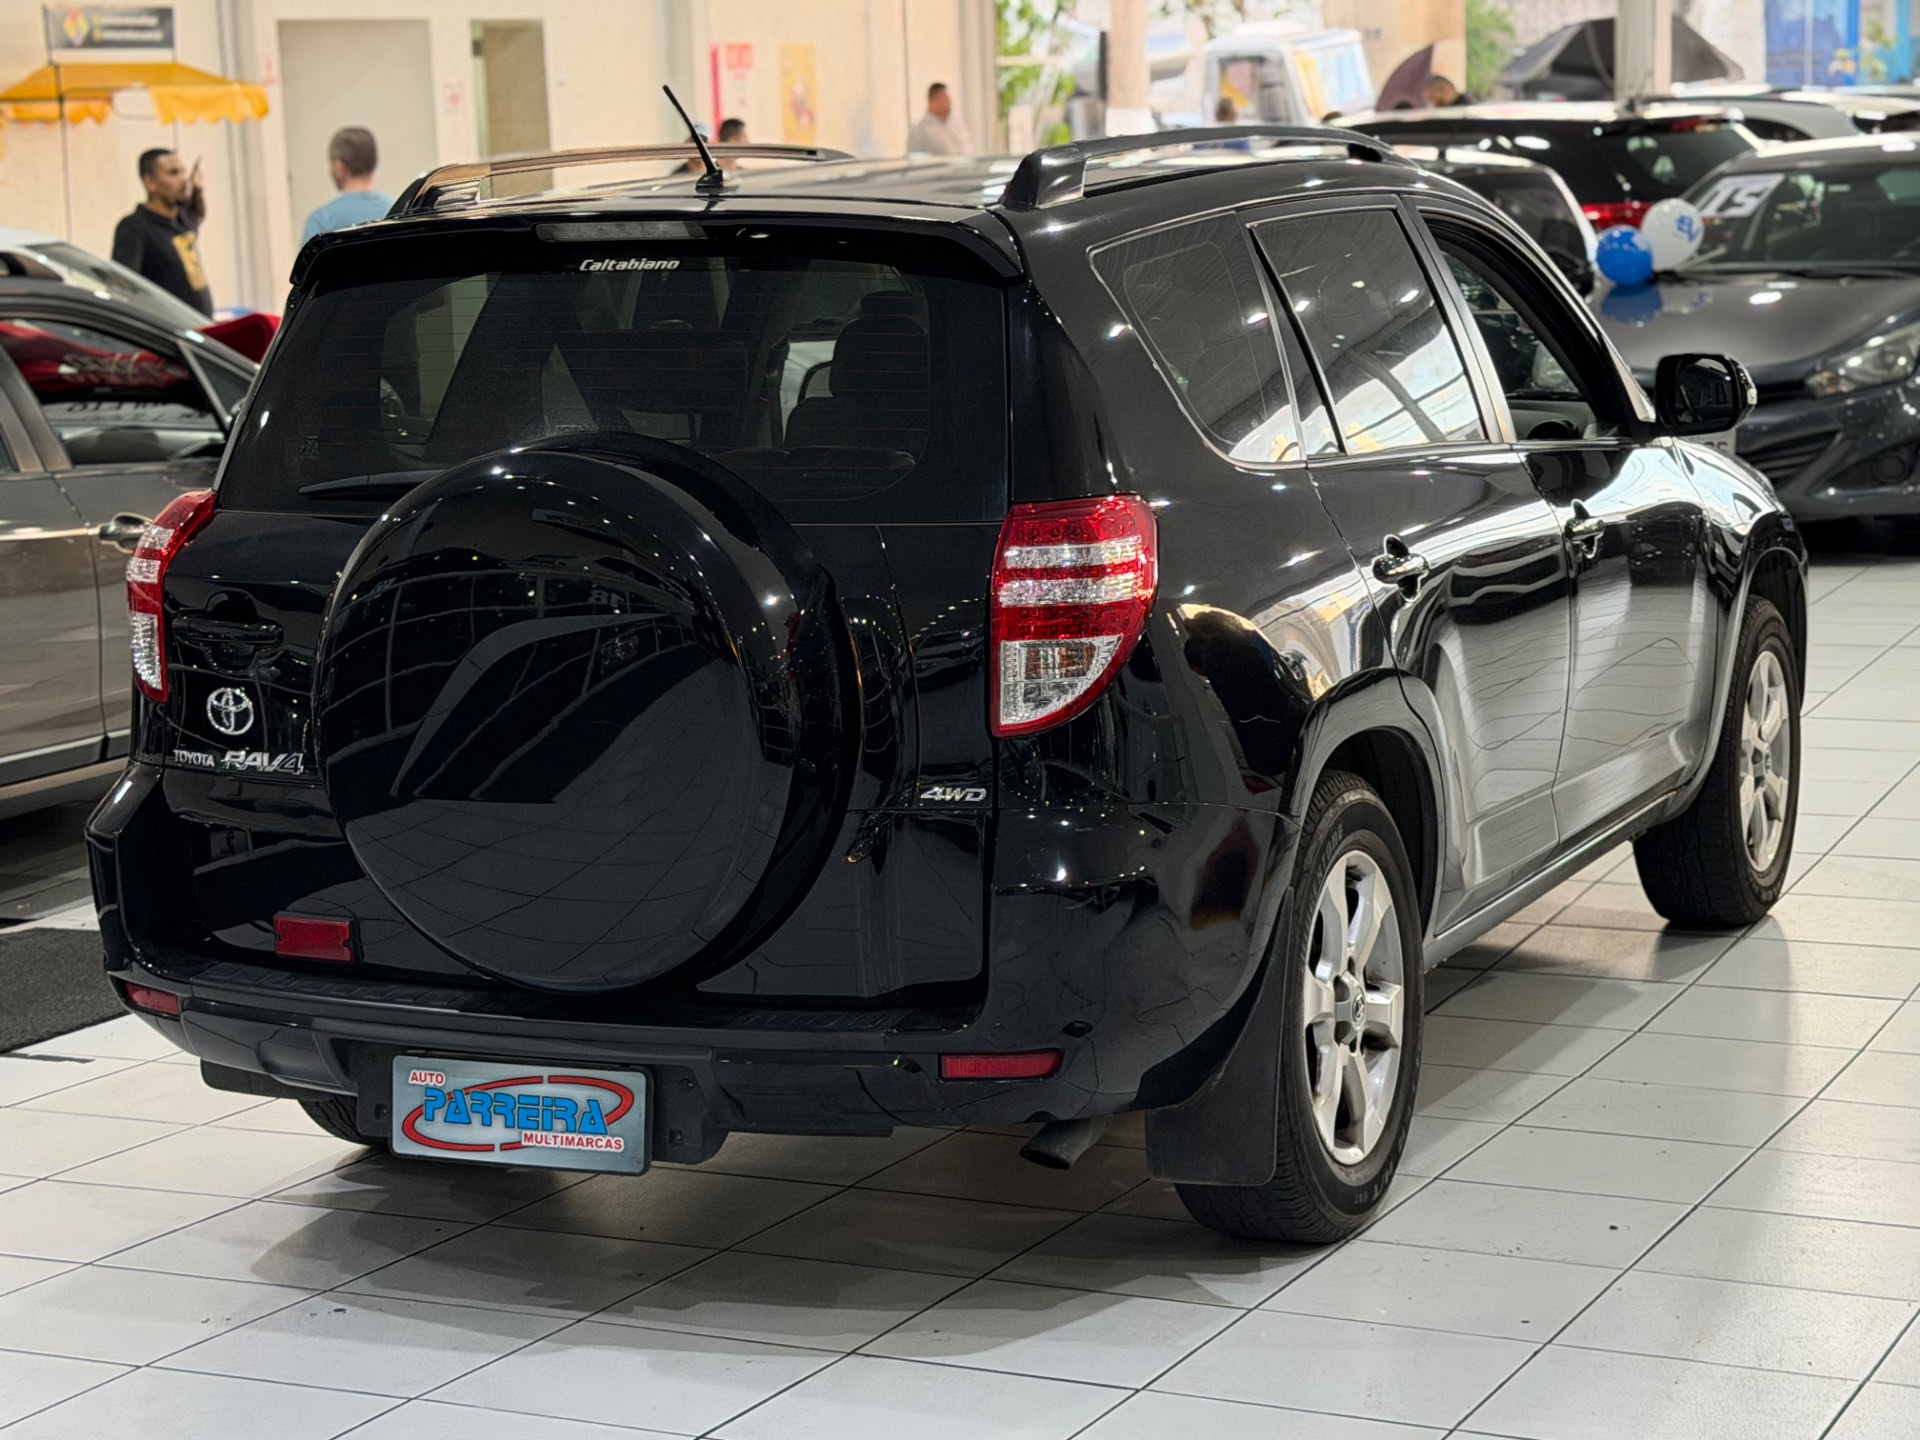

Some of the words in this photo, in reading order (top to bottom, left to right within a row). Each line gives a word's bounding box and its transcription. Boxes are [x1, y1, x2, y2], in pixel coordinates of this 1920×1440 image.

[579, 258, 680, 271] Caltabiano
[173, 749, 215, 768] TOYOTA
[221, 750, 304, 775] RAV4
[920, 786, 987, 801] 4WD
[410, 1071, 445, 1084] AUTO
[424, 1087, 608, 1135] PARREIRA
[523, 1132, 623, 1150] MULTIMARCAS
